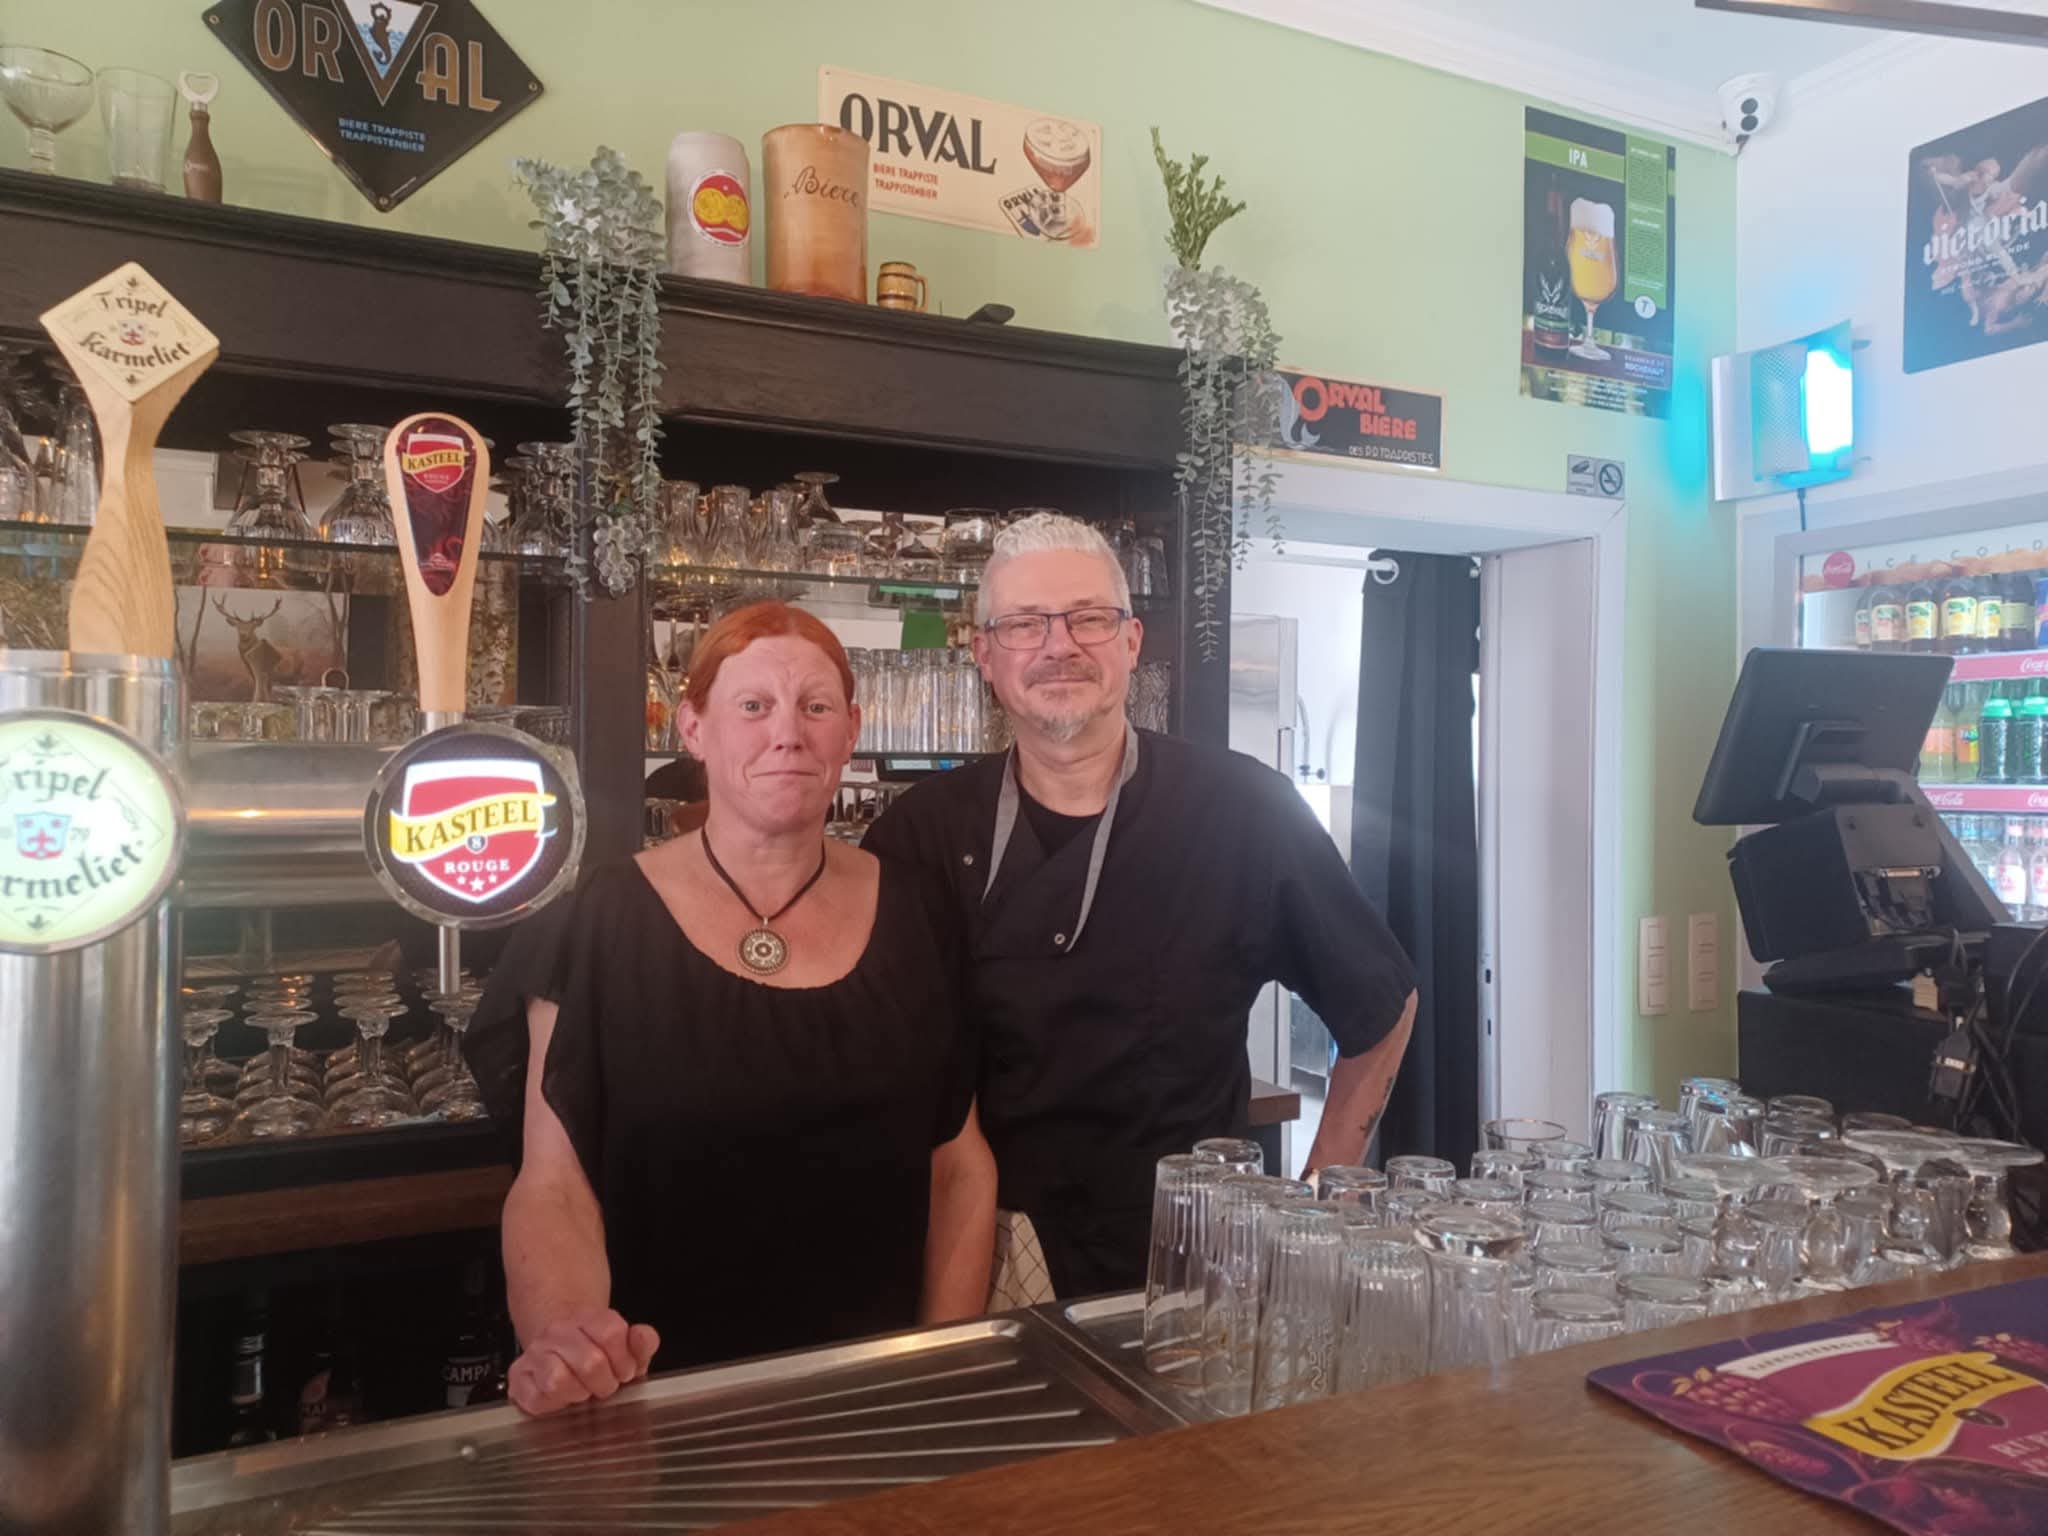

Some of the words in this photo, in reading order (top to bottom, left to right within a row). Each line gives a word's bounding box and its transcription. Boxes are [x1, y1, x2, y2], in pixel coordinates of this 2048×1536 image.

[253, 0, 501, 112] ORVAL
[340, 130, 425, 152] TRAPPISTENBIER
[372, 123, 426, 141] TRAPPISTE
[840, 92, 997, 175] ORVAL
[1568, 148, 1588, 168] IPA
[875, 178, 938, 200] TRAPPISTENBIER
[898, 166, 939, 185] TRAPPISTE
[92, 290, 168, 318] Tripel
[79, 331, 191, 367] Karmeliet
[1293, 376, 1386, 422] ORVAL
[407, 451, 462, 470] KASTEEL
[1348, 445, 1364, 456] DES
[1380, 446, 1434, 465] TRAPPISTES
[1867, 554, 1918, 569] ICE
[1950, 540, 2043, 560] COLD
[0, 751, 110, 803] ripel
[404, 799, 537, 853] KASTEEL
[471, 835, 482, 848] 8
[0, 843, 142, 900] rmeliet
[443, 858, 511, 875] ROUGE
[1838, 1361, 2016, 1450] KASTEEL
